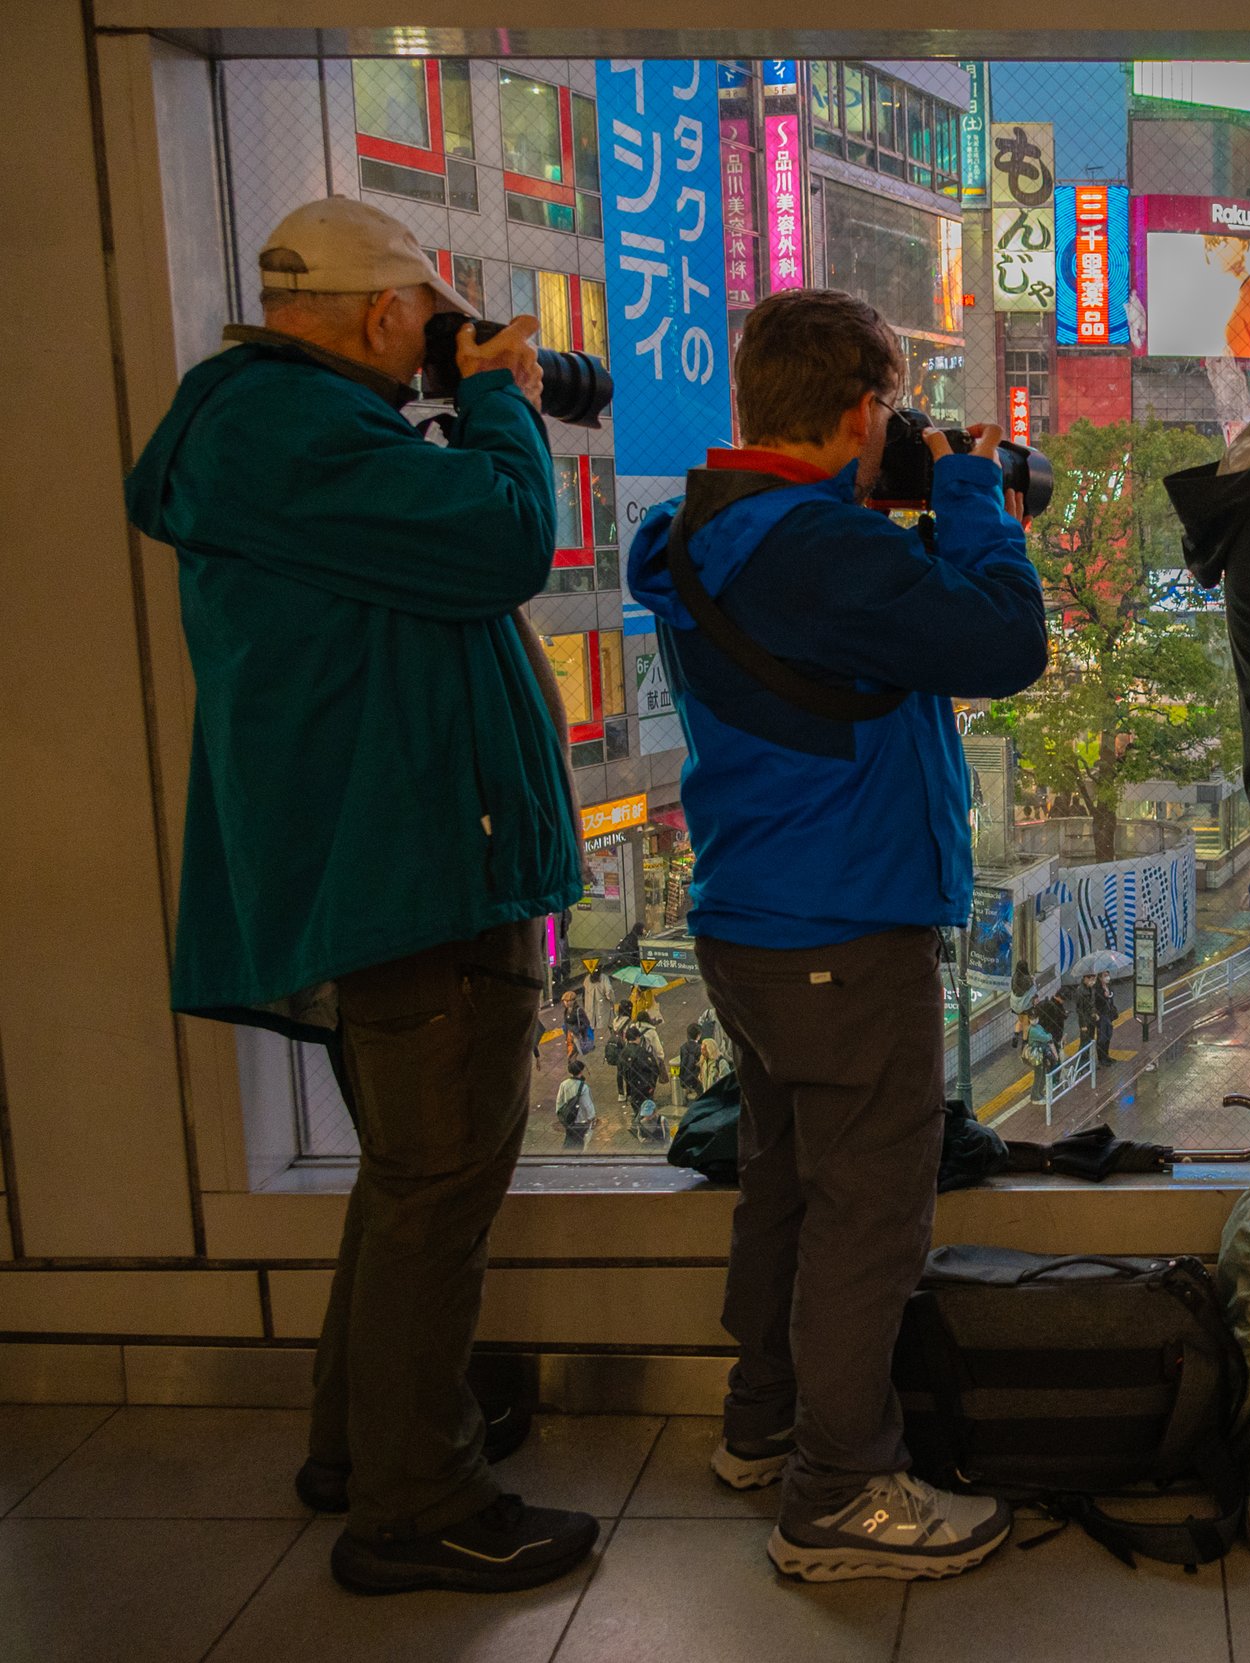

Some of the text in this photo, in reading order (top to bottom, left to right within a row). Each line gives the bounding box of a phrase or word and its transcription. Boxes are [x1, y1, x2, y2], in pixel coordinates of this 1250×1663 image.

[775, 151, 798, 278] 品川美容外科
[994, 126, 1055, 308] もんじゃ
[1079, 194, 1105, 336] 三千里薬品
[636, 657, 650, 675] 6F
[647, 690, 672, 711] 献血
[582, 805, 631, 832] スター銀行
